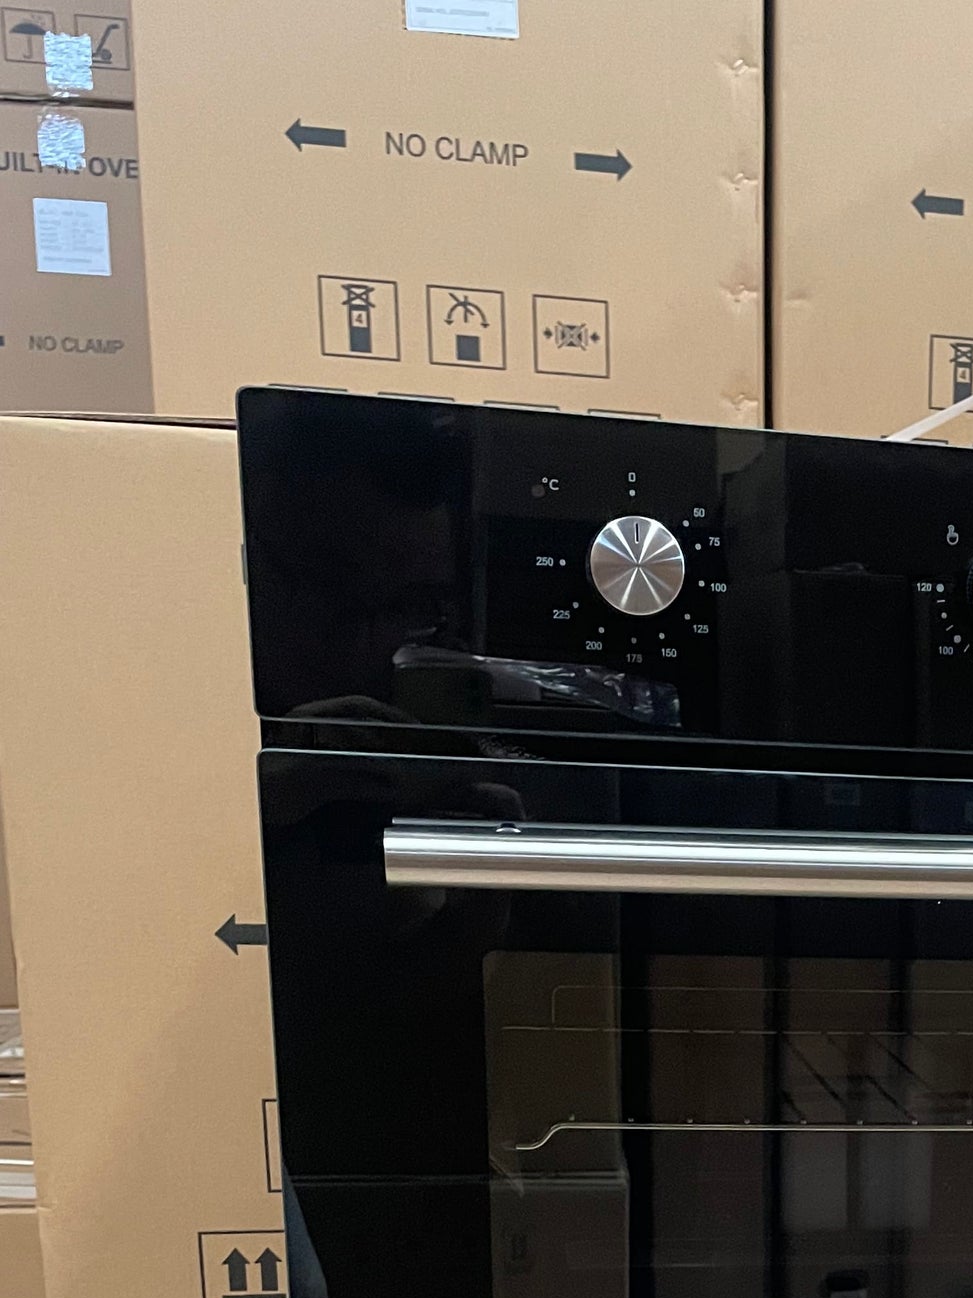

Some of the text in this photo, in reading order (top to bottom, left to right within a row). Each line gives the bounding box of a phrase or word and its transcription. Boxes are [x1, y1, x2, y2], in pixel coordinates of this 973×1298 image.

[385, 131, 529, 167] NO CLAMP
[28, 335, 125, 355] NO CLAMP
[708, 536, 721, 547] 75
[535, 556, 554, 567] 250
[710, 582, 727, 593] 100
[916, 582, 933, 592] 120
[552, 609, 571, 620] 225
[692, 624, 709, 634] 125
[585, 640, 603, 651] 200
[938, 645, 954, 655] 100
[661, 647, 677, 658] 150
